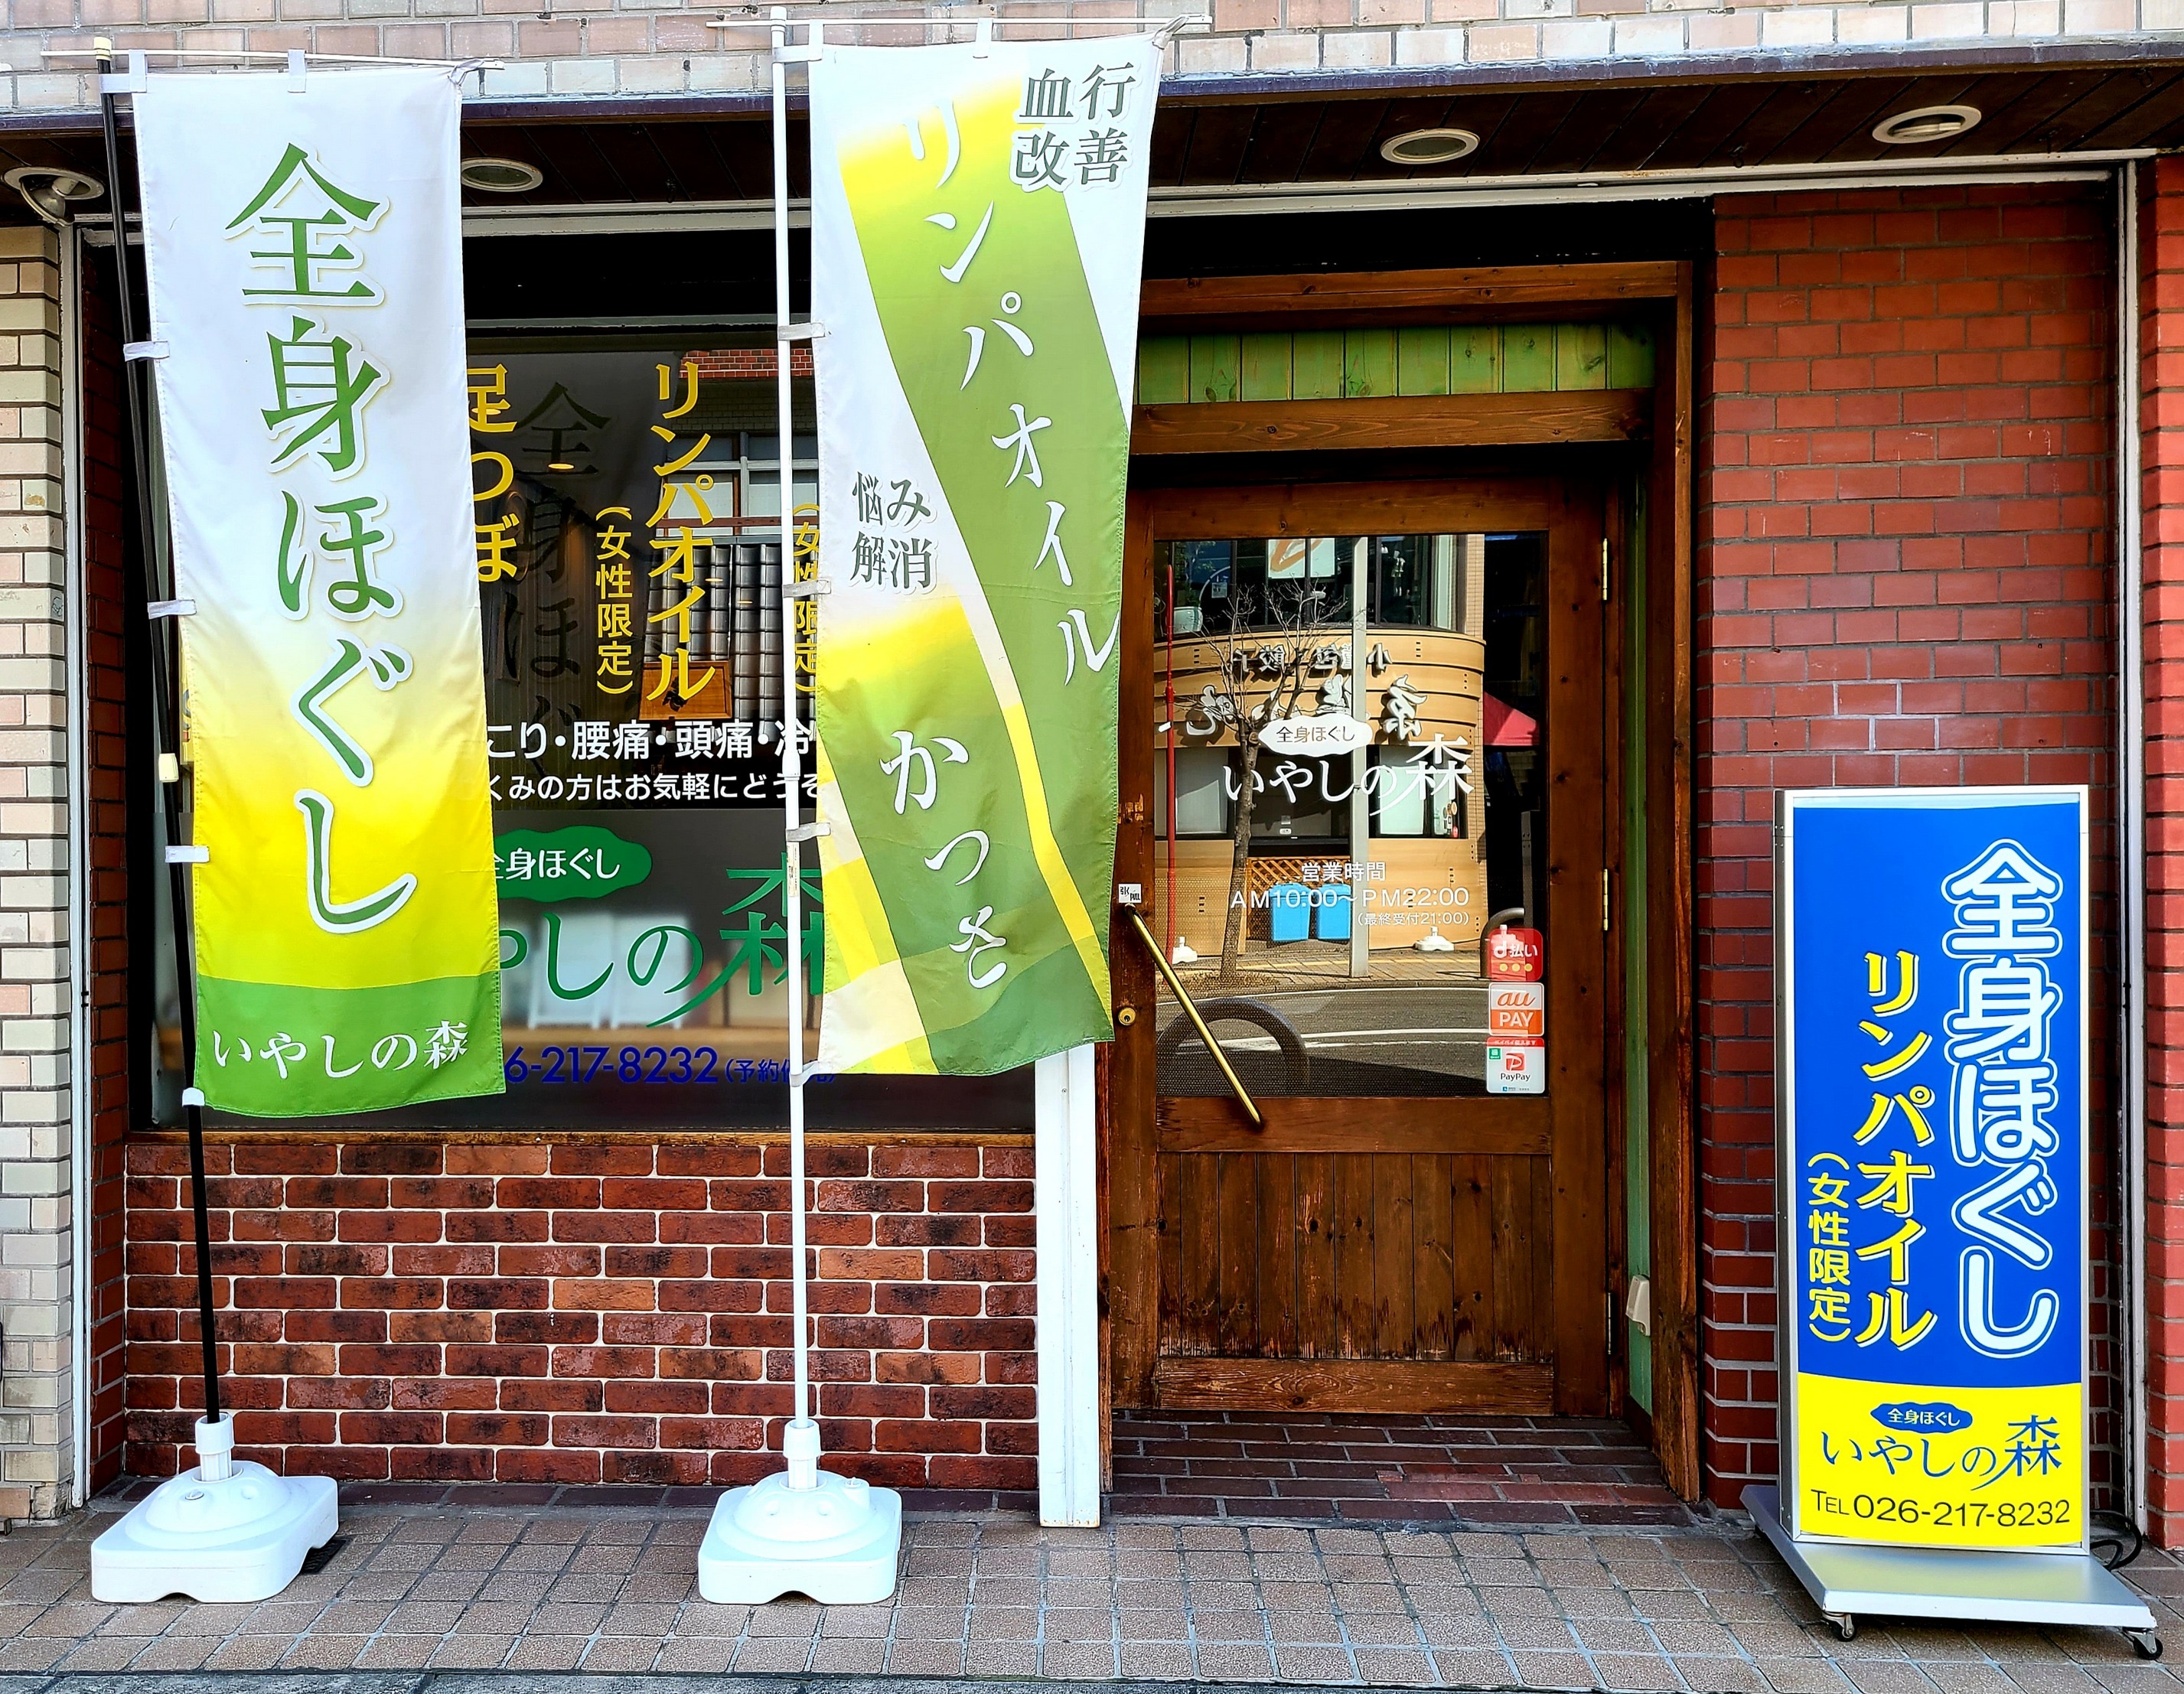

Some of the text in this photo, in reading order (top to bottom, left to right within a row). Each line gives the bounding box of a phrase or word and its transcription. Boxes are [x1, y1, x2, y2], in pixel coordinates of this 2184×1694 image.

[1019, 62, 1136, 120] 血行
[1015, 128, 1129, 187] 改善
[903, 98, 1121, 686] リンパオイル
[467, 363, 520, 583] 足つぼ
[852, 471, 931, 528] 悩み
[224, 142, 416, 933] 全身ほぐし
[645, 362, 716, 702] リンパオイル
[849, 532, 937, 590] 解消
[595, 507, 634, 695] （女性限定）
[1276, 726, 1356, 743] 全身ほぐし
[1224, 733, 1475, 816] いやしの森
[1301, 862, 1386, 882] 営業時間
[1497, 992, 1537, 1007] au
[1499, 1012, 1534, 1028] PAY
[212, 1021, 468, 1080] いやしの森
[504, 1047, 718, 1085] 6-217-8232
[1500, 1073, 1531, 1082] PayPay
[1941, 839, 2064, 1359] 全身ほぐし
[1853, 950, 1938, 1351] リンパオイル
[1808, 1152, 1851, 1342] （女性限定）
[1887, 1408, 1961, 1427] 全身ほぐし
[1820, 1414, 2062, 1491] いやしの森
[1853, 1494, 2070, 1527] 026-217-8232
